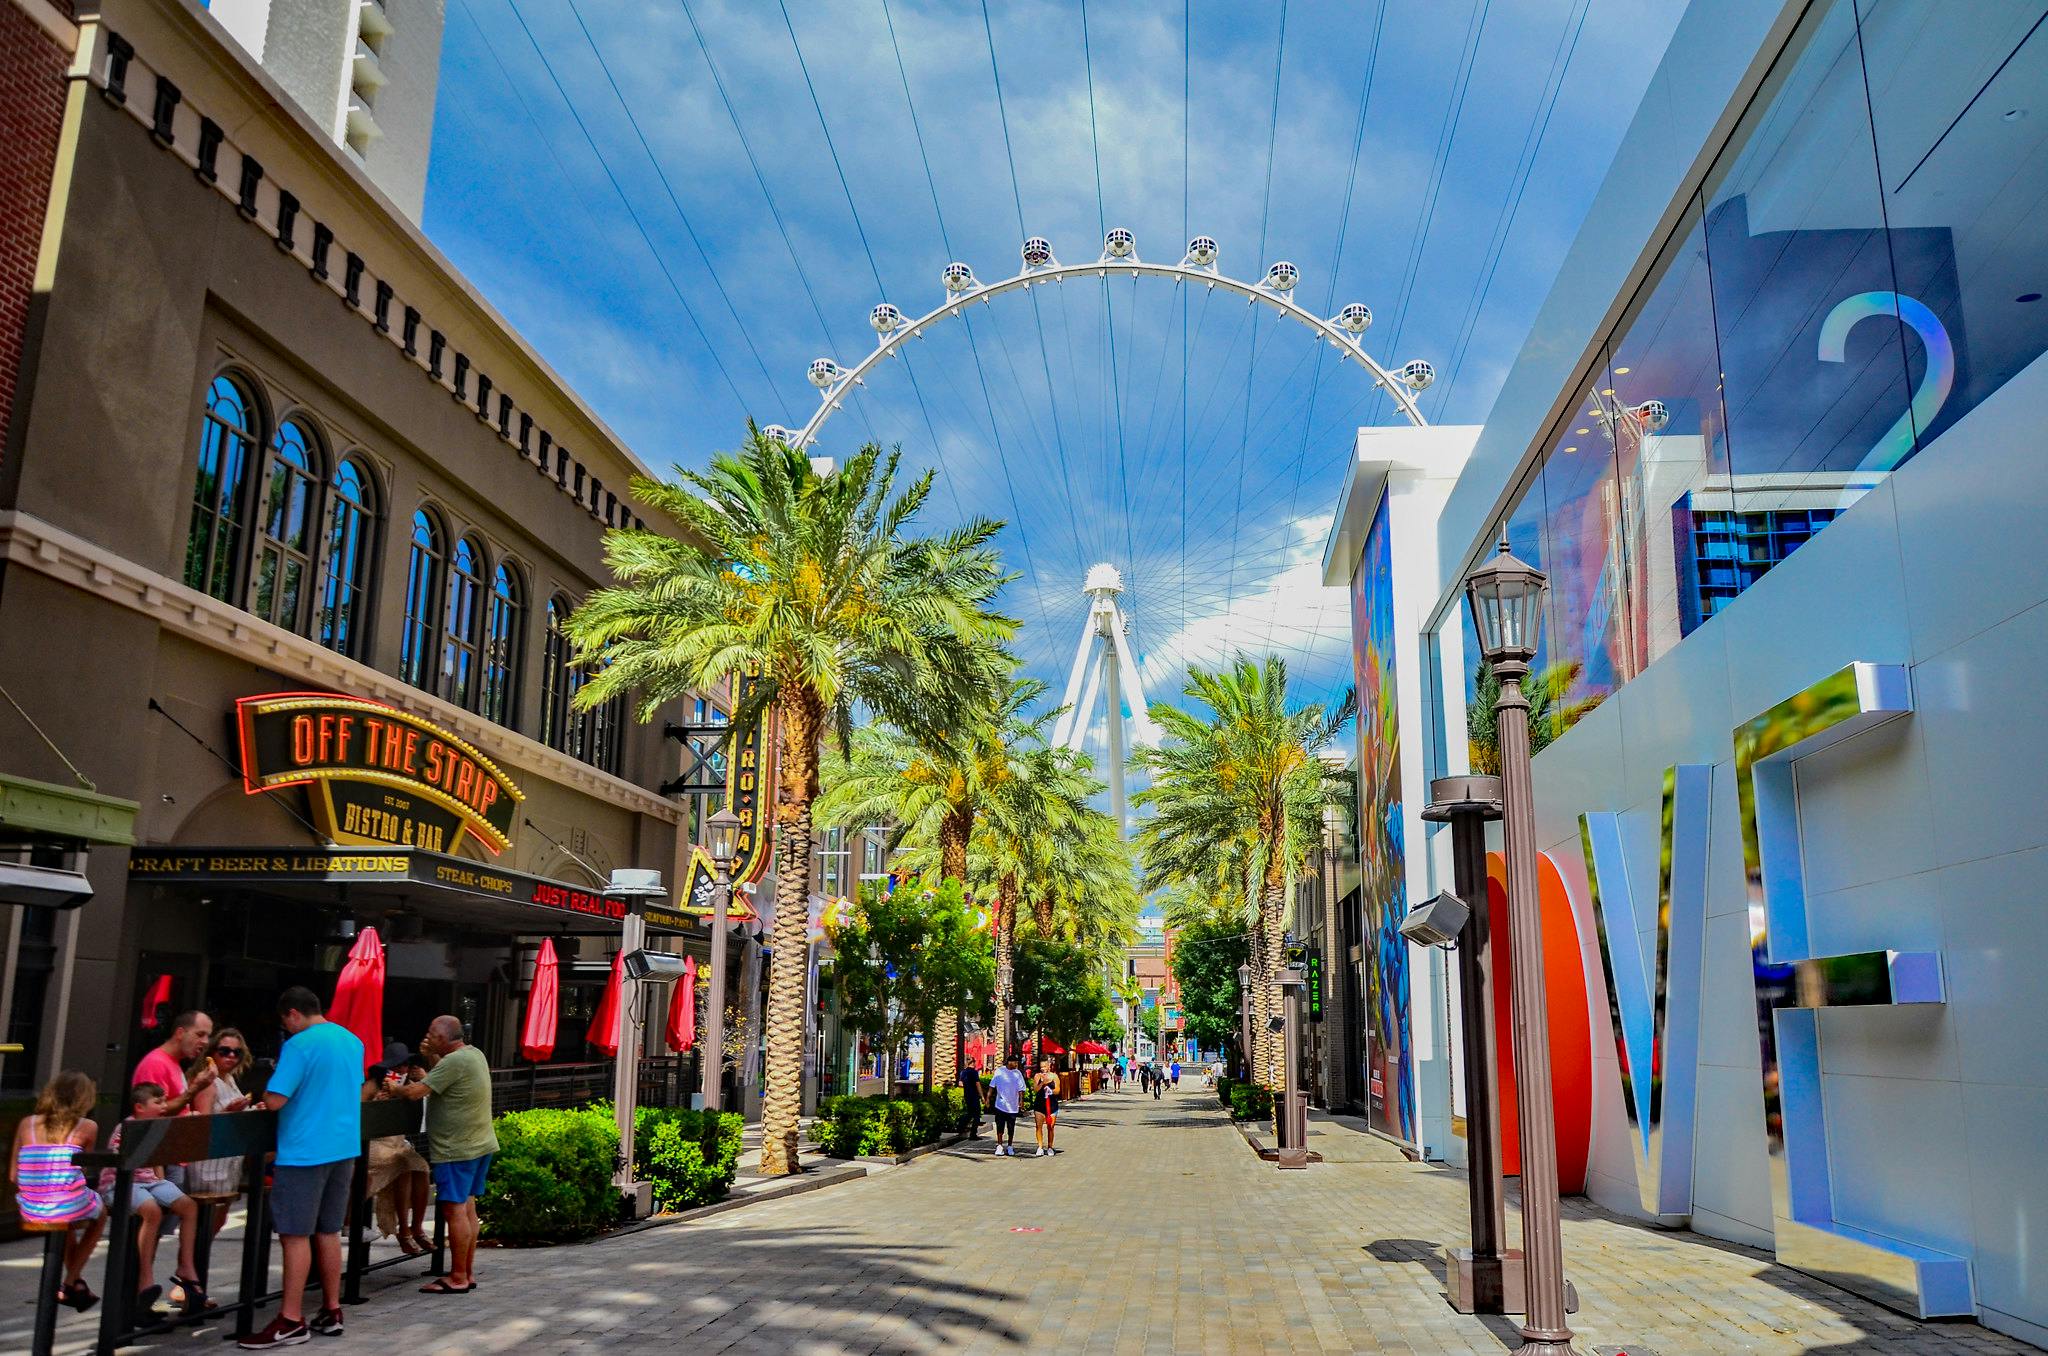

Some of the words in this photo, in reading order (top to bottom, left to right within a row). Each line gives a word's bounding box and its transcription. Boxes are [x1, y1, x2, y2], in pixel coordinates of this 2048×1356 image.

[290, 713, 354, 766] OFF
[365, 717, 421, 775] THE
[426, 740, 499, 816] STRIP
[343, 802, 400, 843] BISTRO
[402, 818, 414, 845] &
[417, 821, 443, 853] BAR
[128, 857, 204, 872] CRAFT
[209, 858, 268, 872] BEER
[272, 858, 288, 872] &
[291, 856, 408, 873] LIBATIONS
[436, 865, 475, 886] STEAK
[480, 874, 513, 895] CHOPS
[531, 883, 569, 908] JUST
[570, 891, 603, 915] REAL
[605, 899, 626, 920] FOO
[674, 916, 693, 929] PASTA
[1310, 957, 1321, 1012] RAZER
